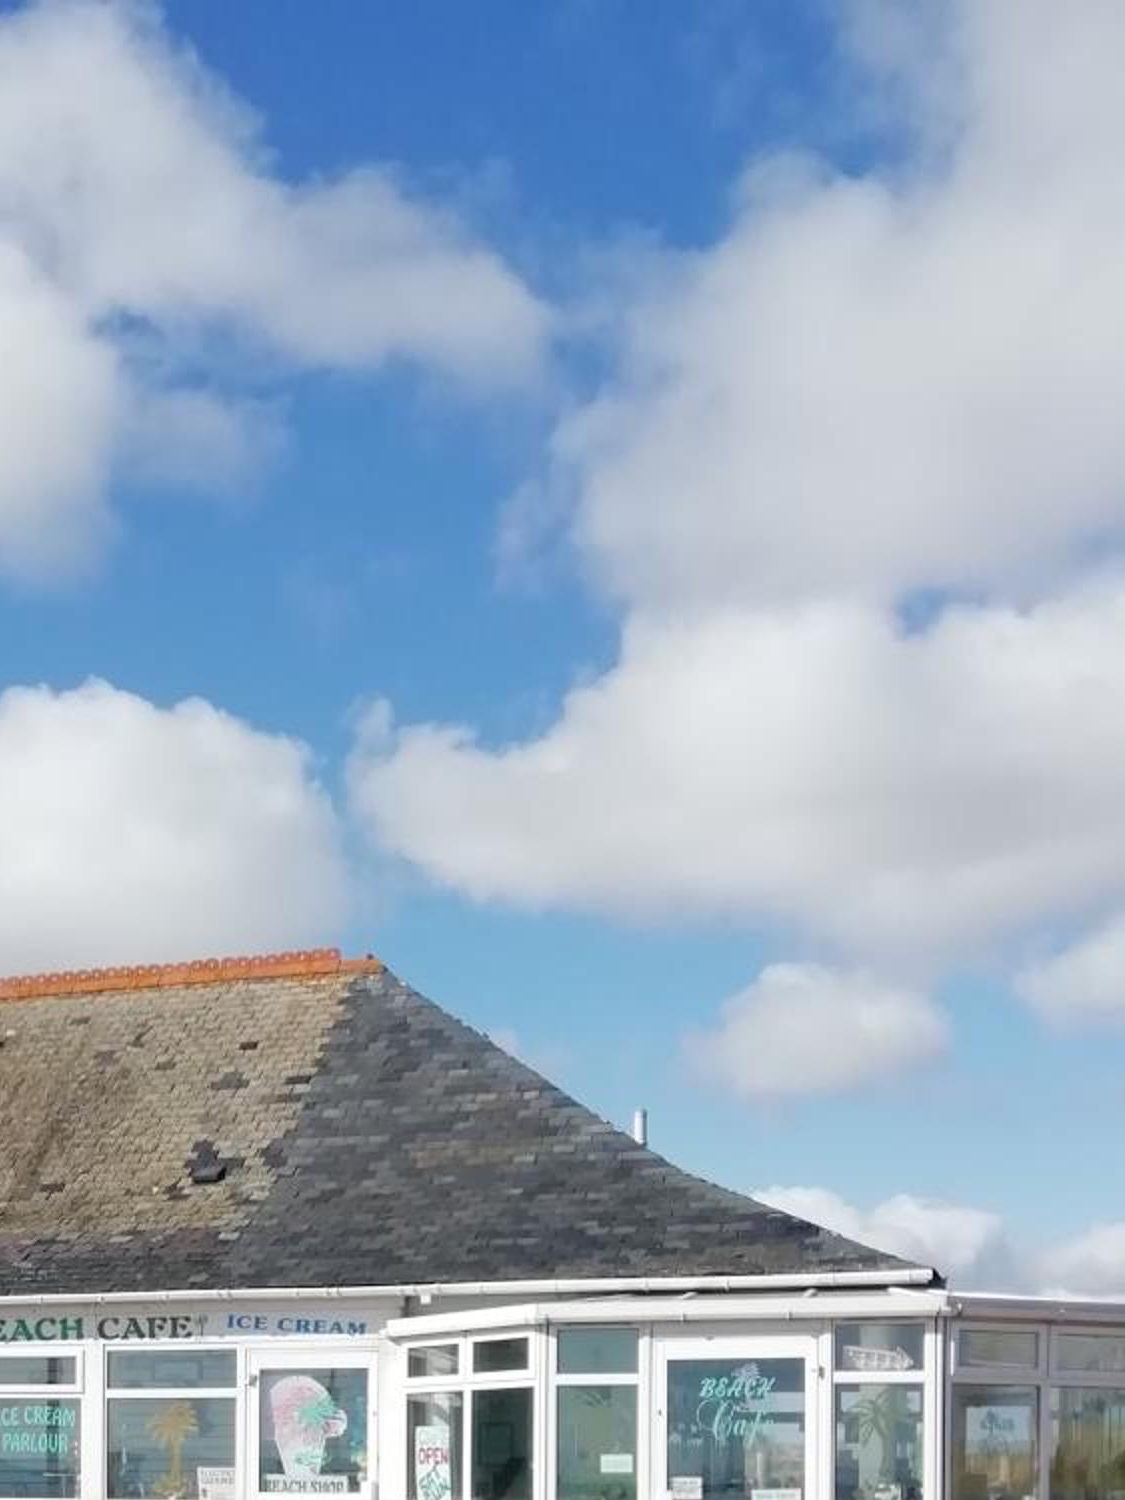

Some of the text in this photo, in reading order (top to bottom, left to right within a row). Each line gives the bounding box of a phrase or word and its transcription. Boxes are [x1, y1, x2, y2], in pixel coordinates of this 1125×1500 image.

[97, 1316, 193, 1340] CAFE
[227, 1314, 366, 1335] ICE CREAM
[699, 1377, 776, 1398] BEACH
[24, 1406, 75, 1427] CREAM
[2, 1432, 68, 1453] PARLOUR
[418, 1447, 448, 1465] OPEN
